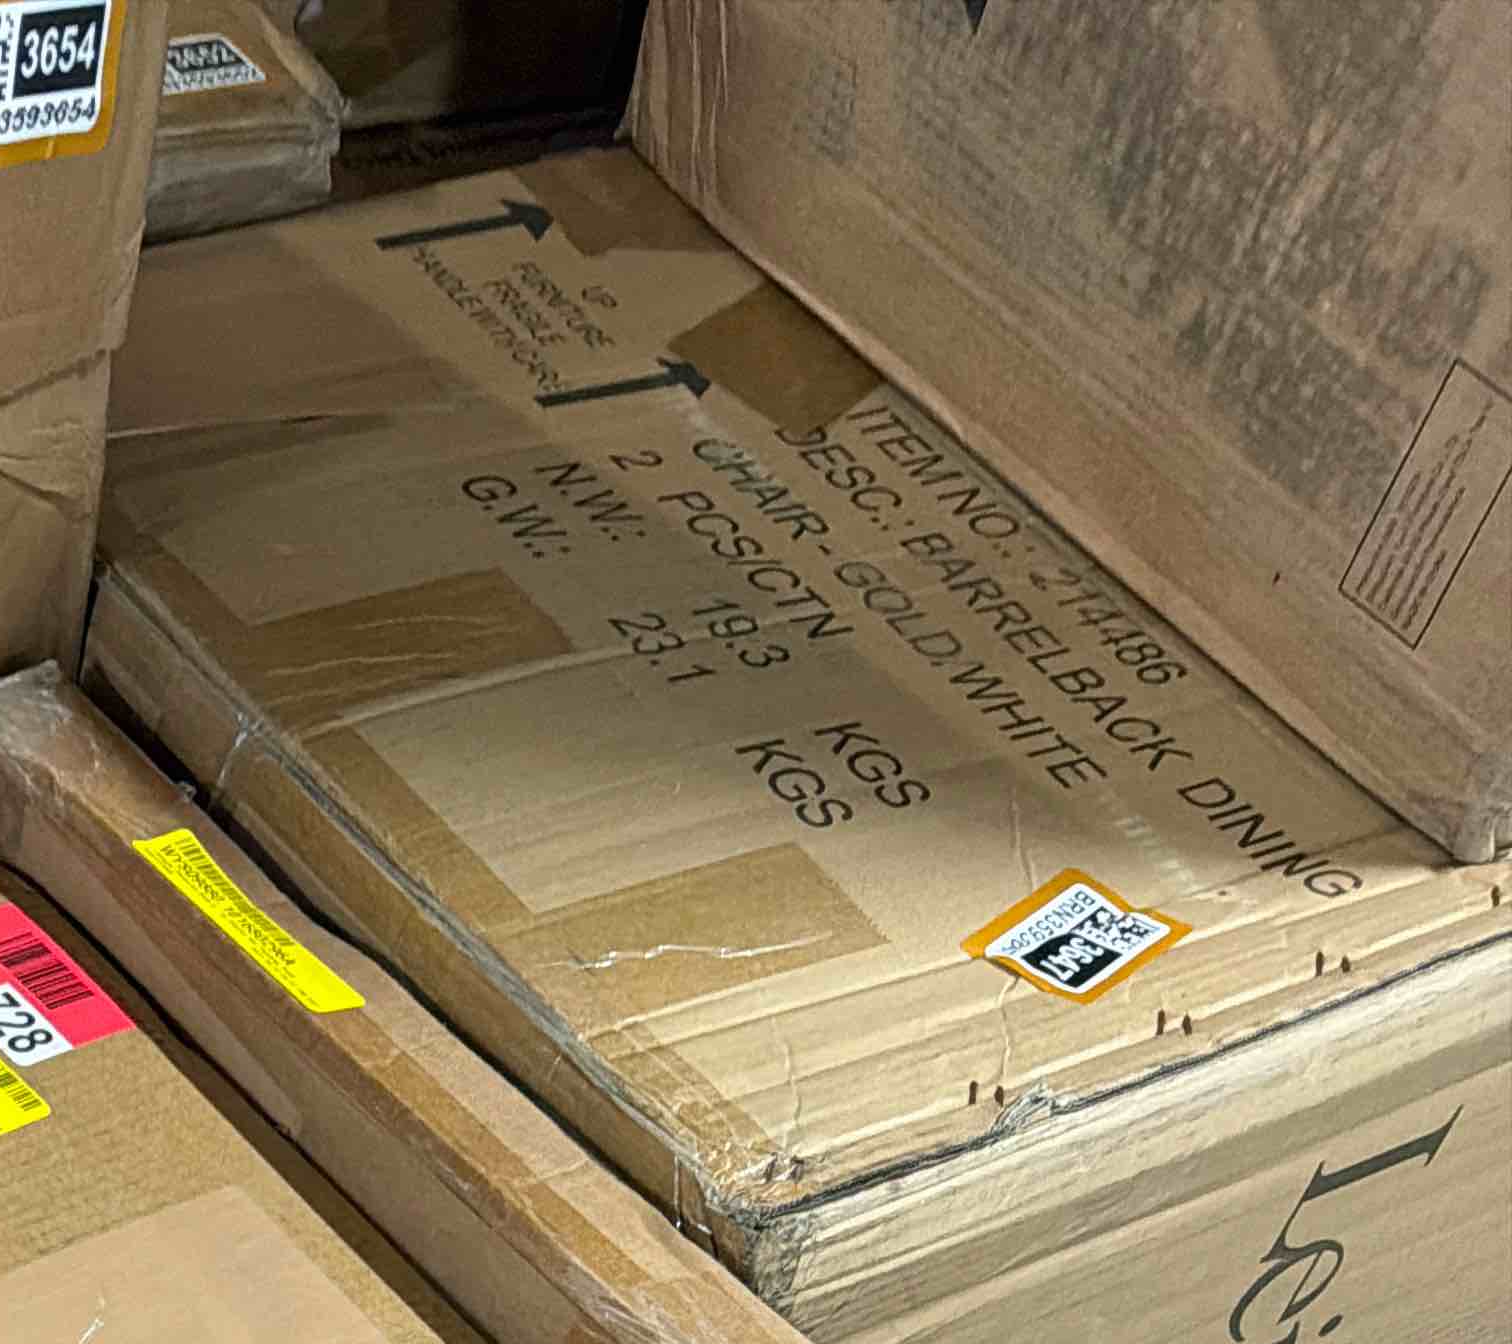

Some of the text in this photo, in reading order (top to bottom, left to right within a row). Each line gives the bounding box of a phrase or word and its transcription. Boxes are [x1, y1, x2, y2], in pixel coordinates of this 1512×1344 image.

[20, 22, 97, 79] 3654
[692, 438, 829, 540] CHAIR
[845, 406, 964, 486] ITEM
[610, 450, 854, 640] 2 PCS/CTN
[607, 612, 717, 683] 23.1
[735, 739, 854, 829] KGS
[692, 601, 789, 669] 19.3
[814, 722, 931, 809] KGS
[899, 532, 1193, 771] BARRELBACK
[1177, 778, 1363, 898] DINING
[1040, 936, 1105, 982] 3647
